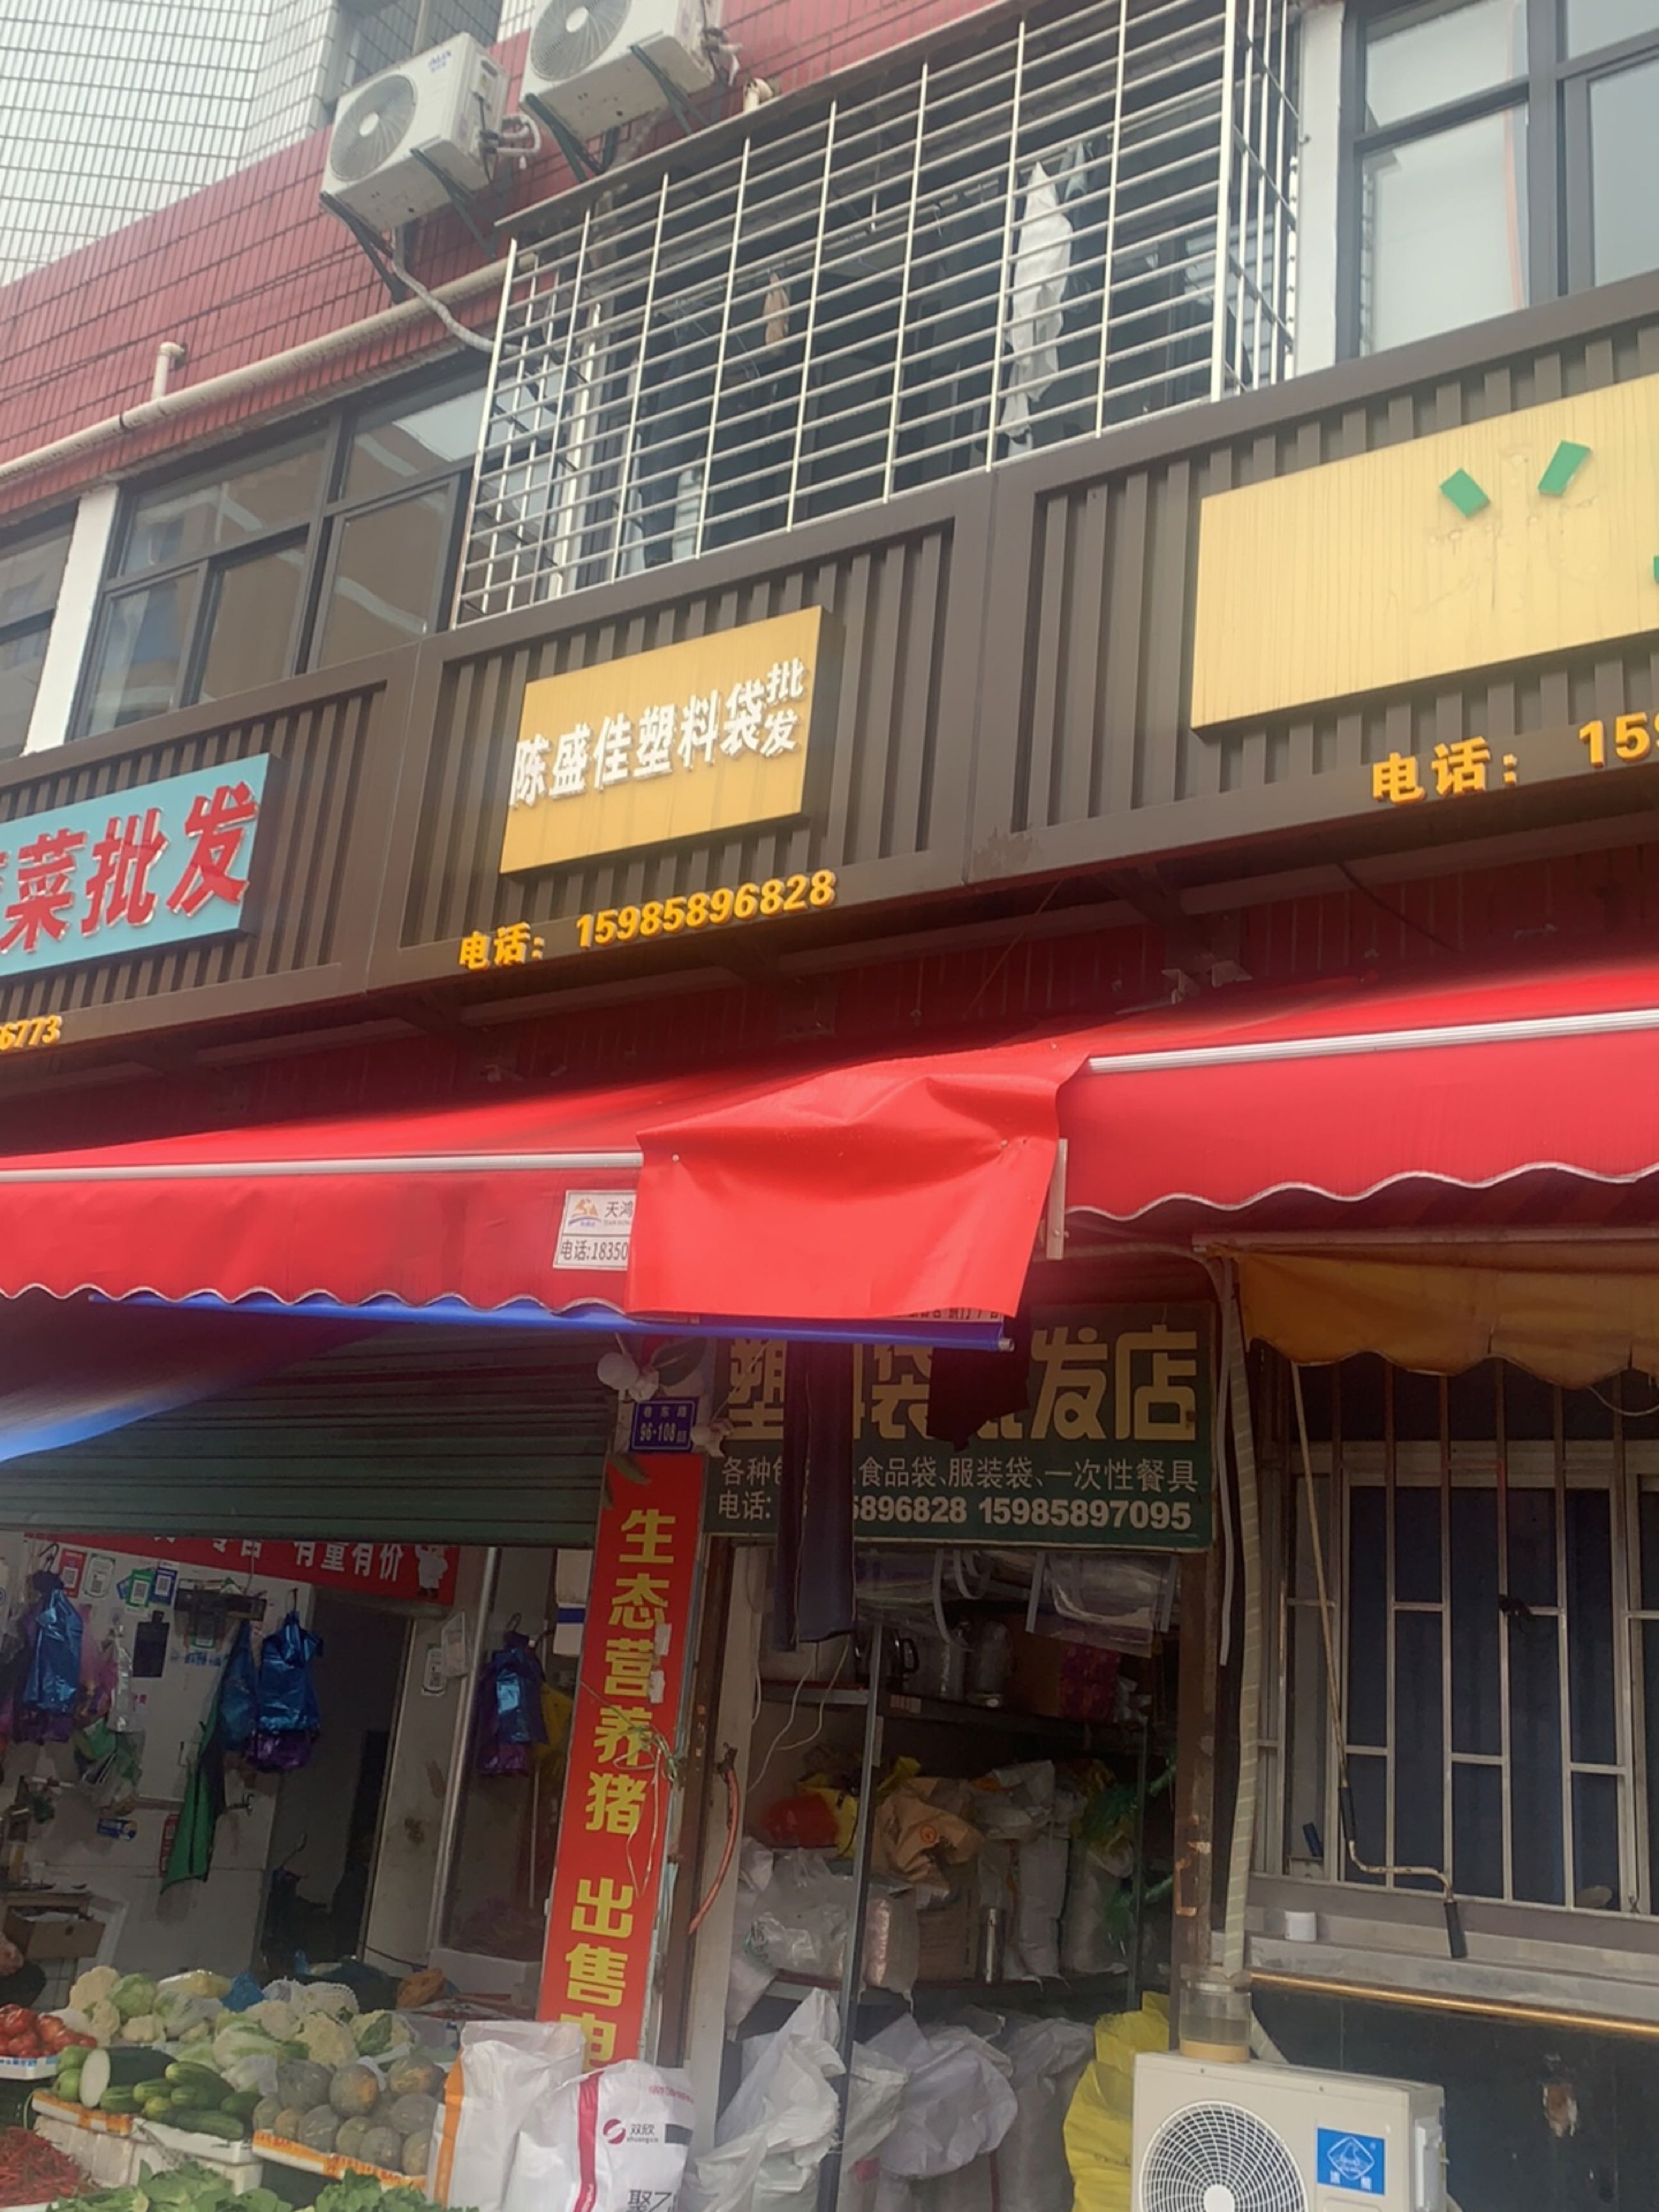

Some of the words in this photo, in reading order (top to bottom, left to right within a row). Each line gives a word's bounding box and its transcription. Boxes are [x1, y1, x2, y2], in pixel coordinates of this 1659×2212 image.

[1579, 712, 1659, 769] 15
[0, 781, 259, 954] 菜批发
[576, 869, 836, 949] 15985896828
[0, 1015, 63, 1051] 6773
[853, 1496, 968, 1523] 896828
[977, 1496, 1192, 1530] 15985897095
[585, 1509, 676, 1835] 生态营养猪
